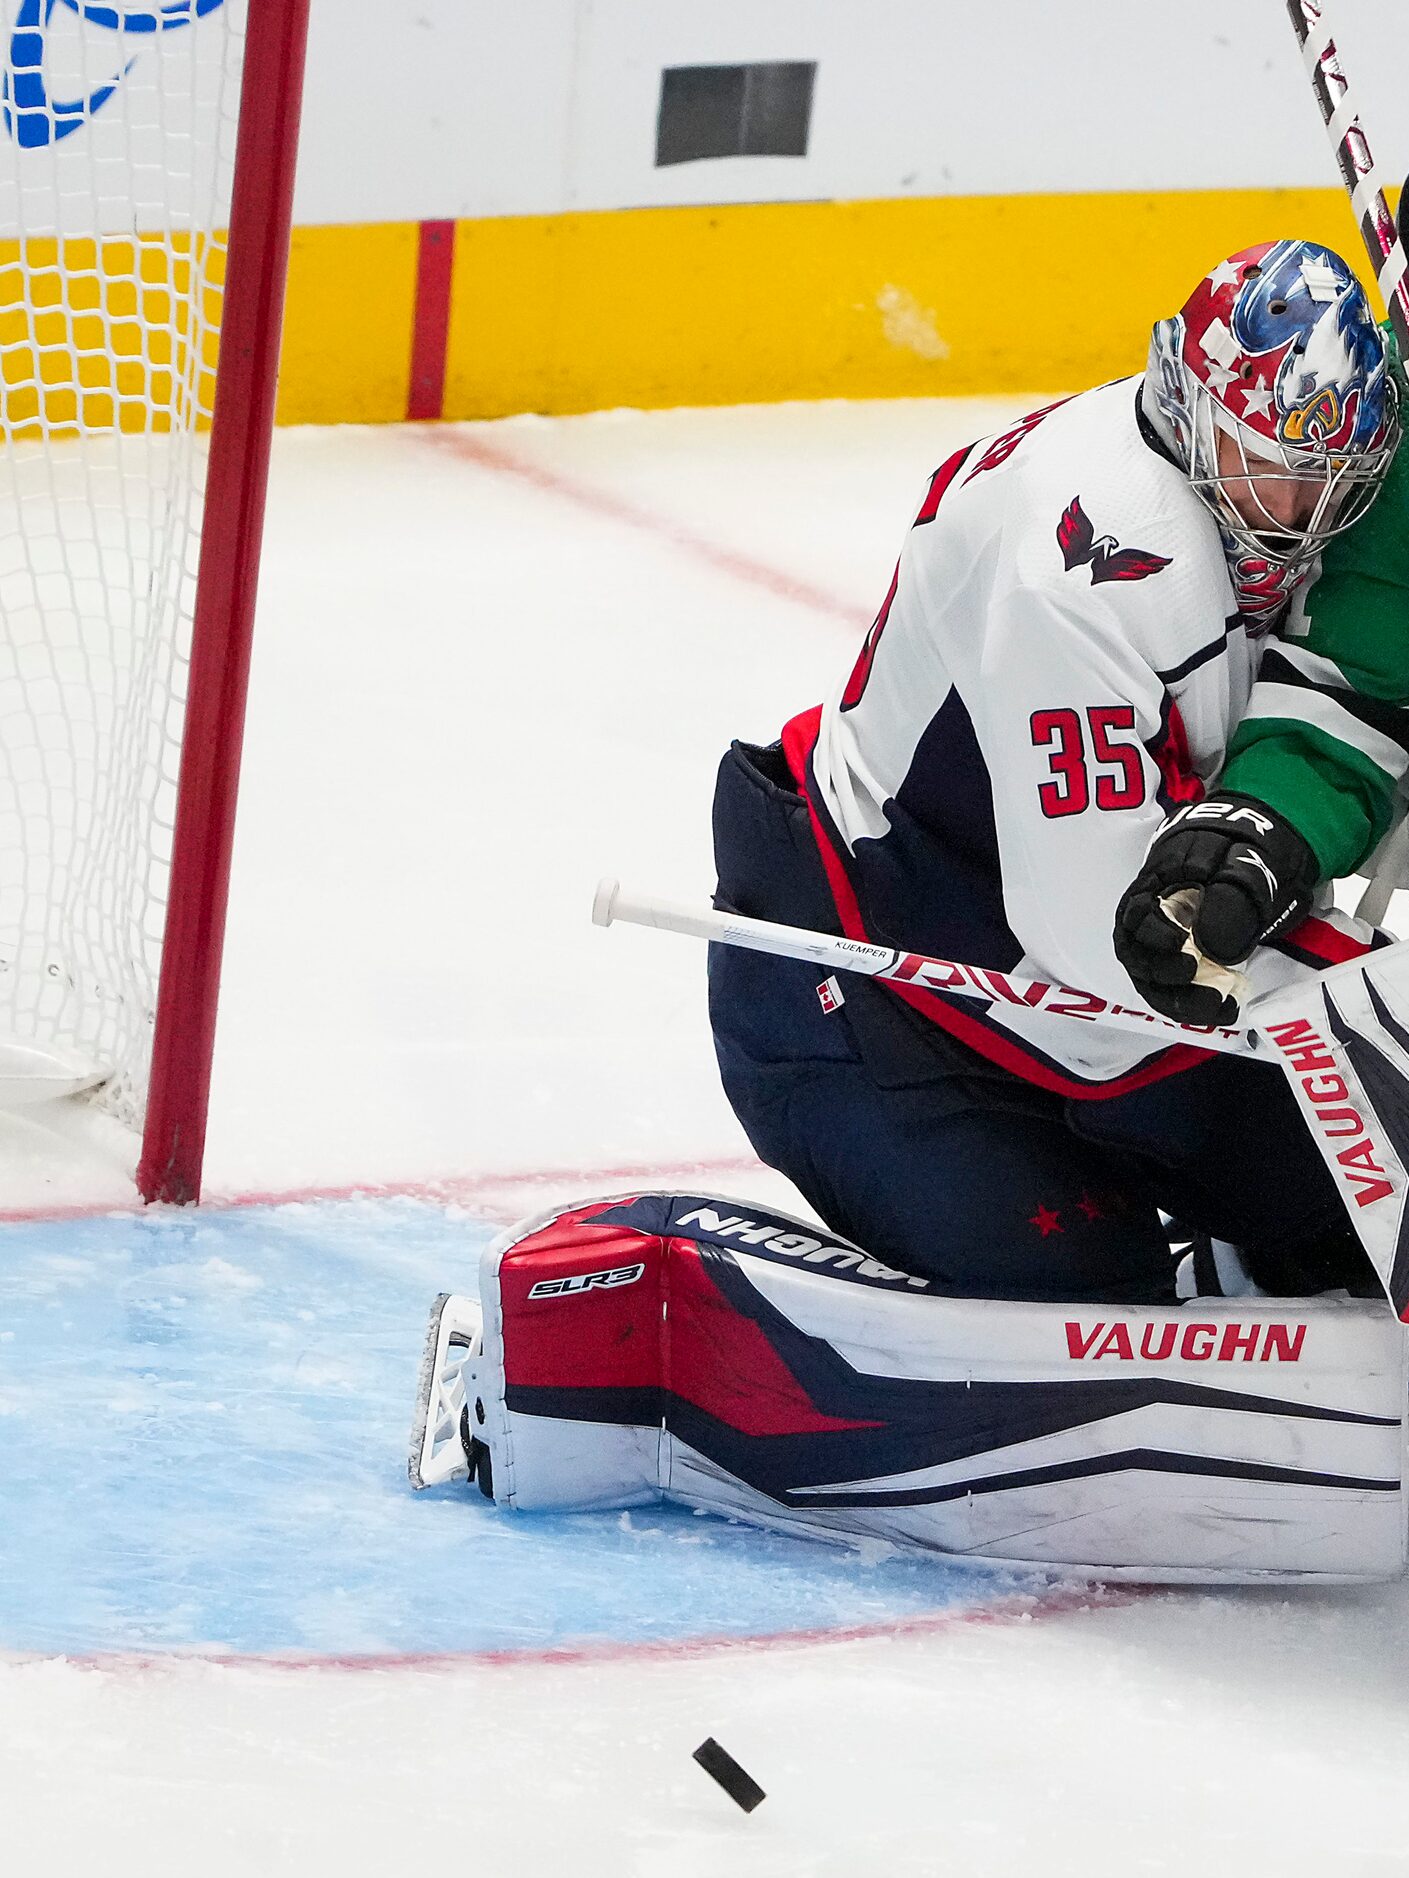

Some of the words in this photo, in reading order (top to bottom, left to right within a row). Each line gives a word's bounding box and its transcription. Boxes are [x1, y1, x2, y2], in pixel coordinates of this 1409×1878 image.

[1029, 705, 1146, 820] 35
[834, 941, 887, 959] KUEMPER
[1264, 1018, 1394, 1208] VAUGHN
[531, 1265, 640, 1297] SLR3
[1064, 1322, 1307, 1362] VAUGHN
